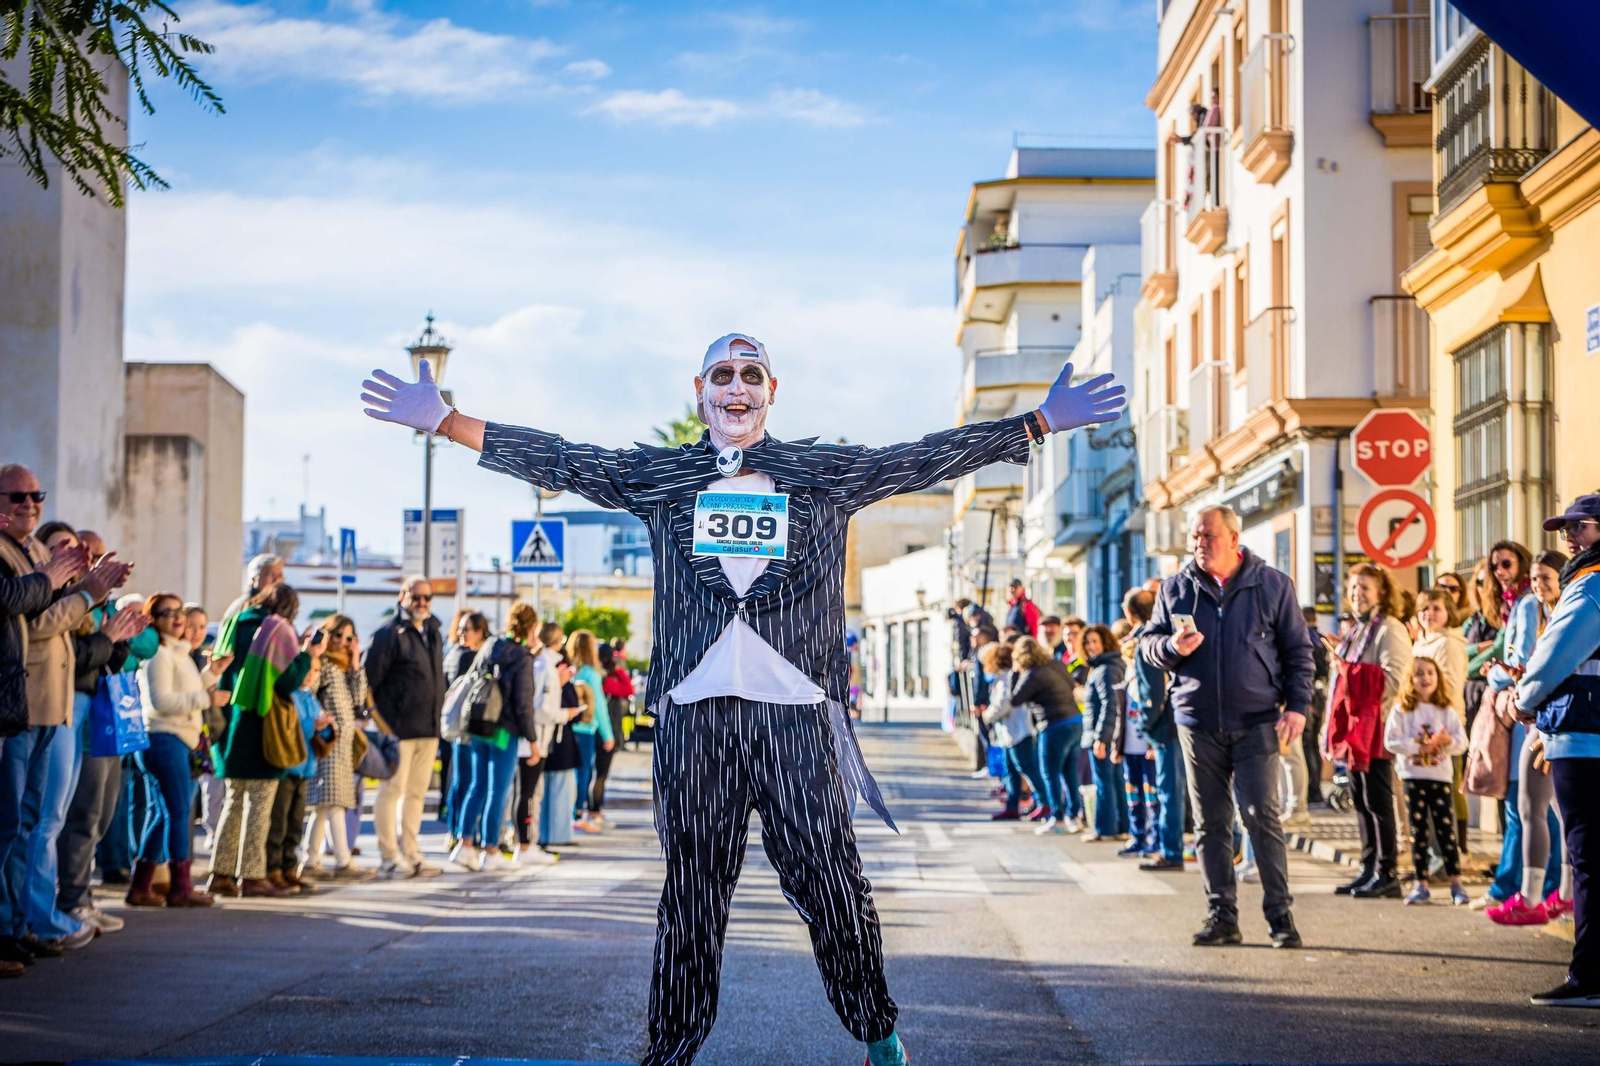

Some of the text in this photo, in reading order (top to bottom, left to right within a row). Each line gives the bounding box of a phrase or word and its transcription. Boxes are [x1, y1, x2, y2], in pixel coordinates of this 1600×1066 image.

[1358, 438, 1429, 460] STOP
[708, 513, 777, 540] 309
[722, 545, 753, 554] cajasur
